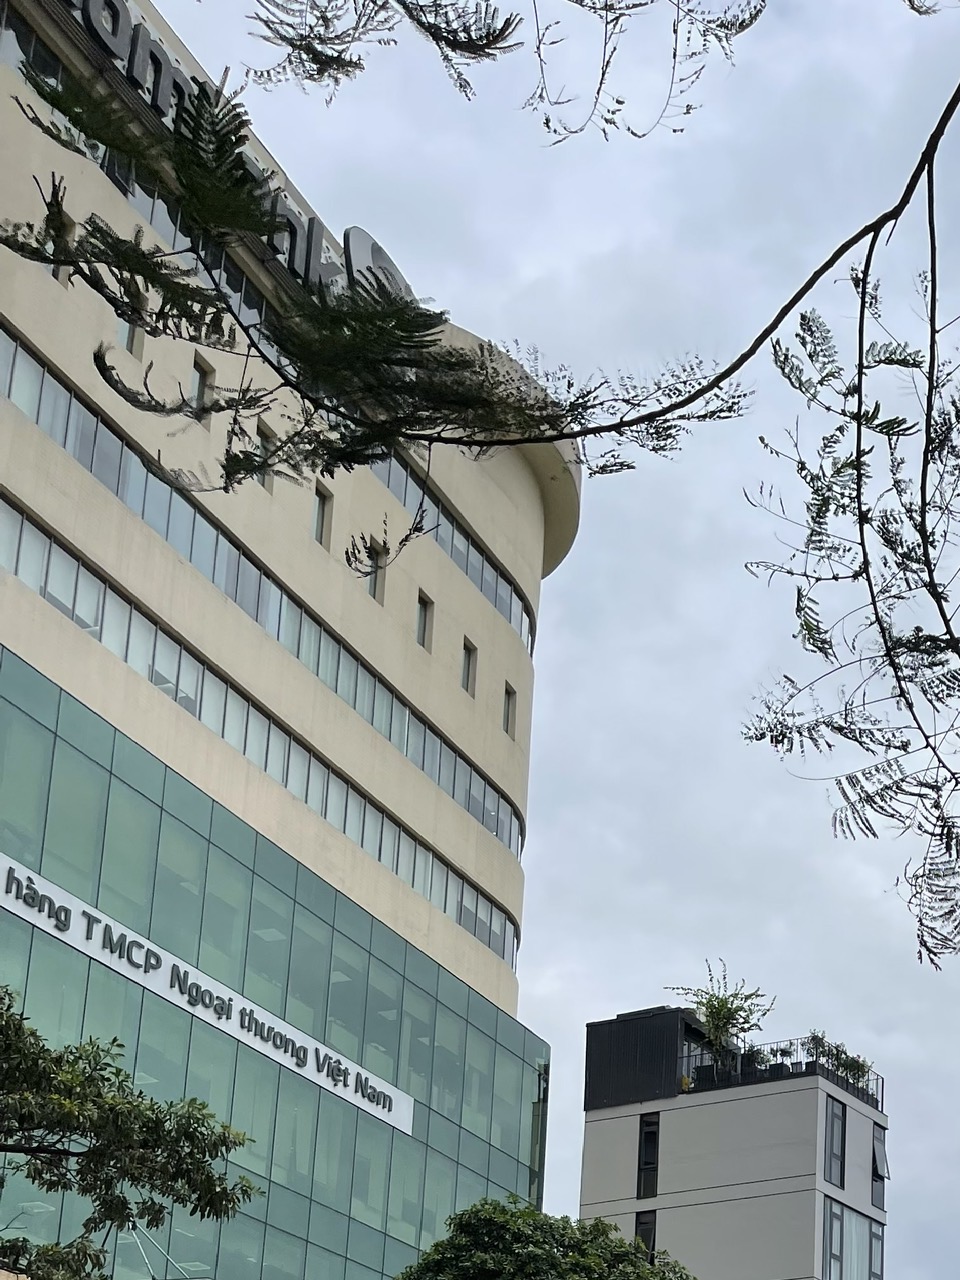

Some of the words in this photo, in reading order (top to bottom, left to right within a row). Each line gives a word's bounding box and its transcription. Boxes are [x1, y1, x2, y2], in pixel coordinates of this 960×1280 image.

[5, 866, 72, 932] hàng
[82, 909, 162, 973] TMCP
[170, 963, 233, 1020] Ngoại
[239, 1006, 308, 1068] thương
[314, 1047, 351, 1088] Việt
[354, 1071, 393, 1113] Nam
